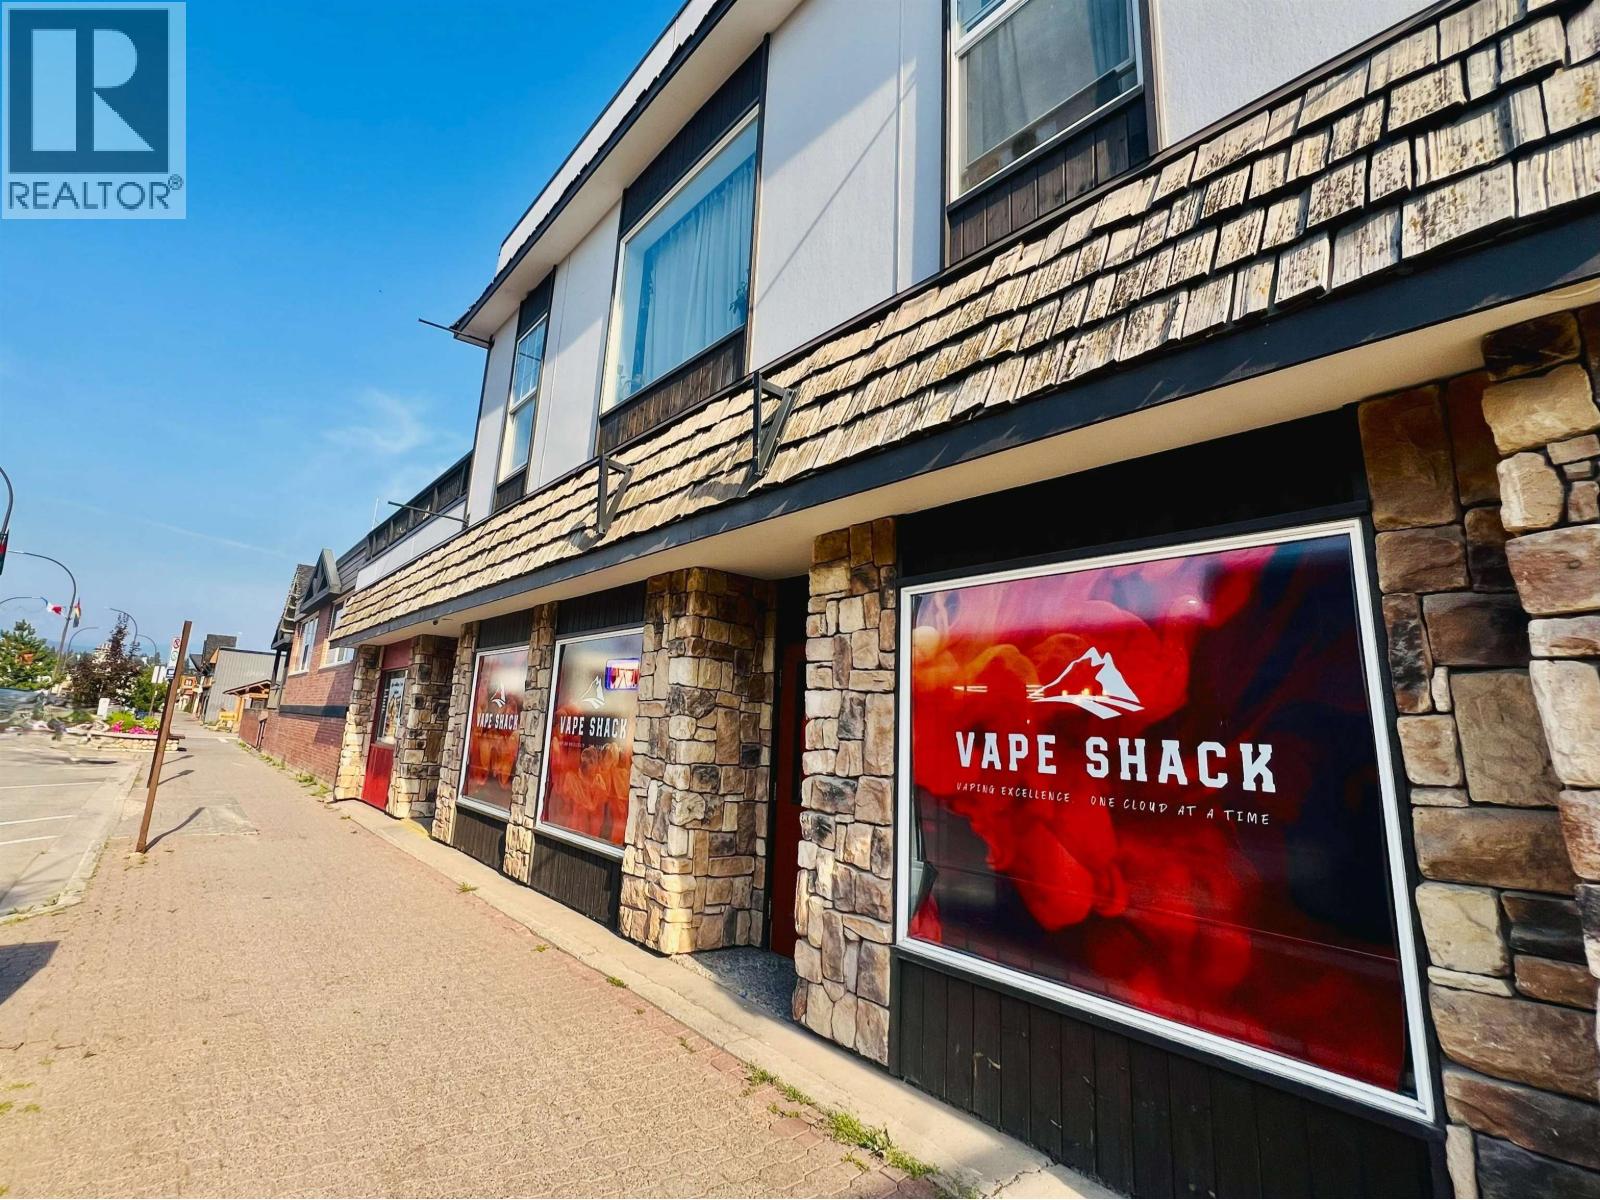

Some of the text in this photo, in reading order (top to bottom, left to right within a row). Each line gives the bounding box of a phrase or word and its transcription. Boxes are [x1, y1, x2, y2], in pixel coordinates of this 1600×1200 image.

[477, 713, 519, 730] VAPE SHACK
[560, 716, 628, 739] VAPE SHACK
[955, 731, 1277, 793] VAPE SHACK
[956, 782, 995, 796] VAPING
[1090, 795, 1115, 808] ONE
[1123, 798, 1168, 813] CLOUD
[1177, 805, 1197, 817] AT
[1206, 808, 1214, 819] A
[1223, 809, 1270, 825] TIME
